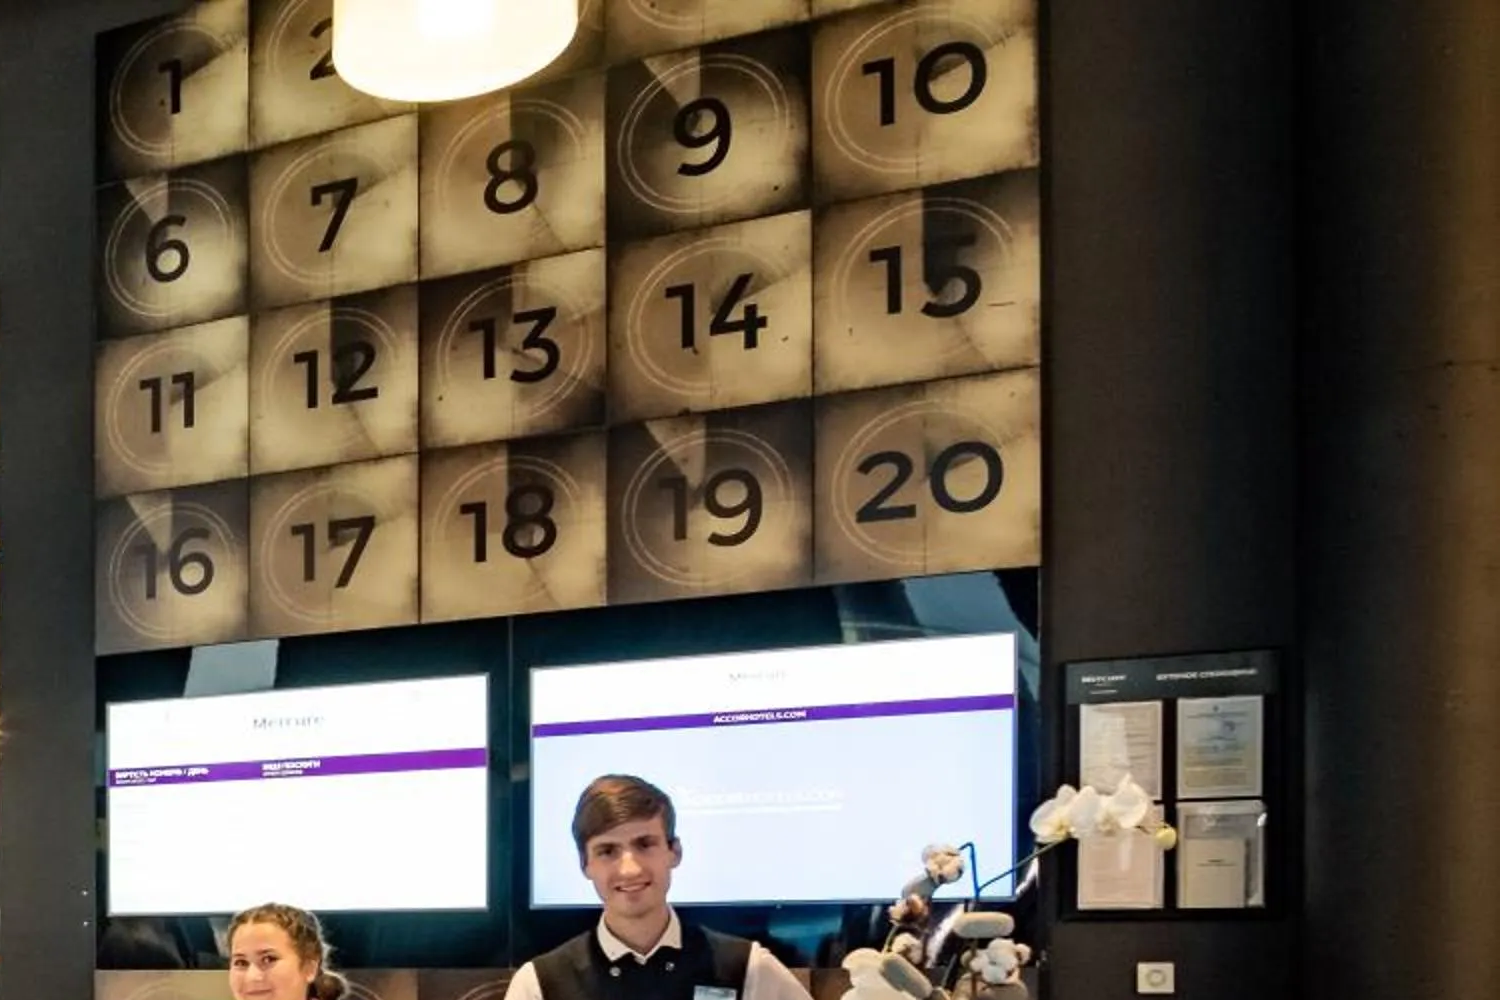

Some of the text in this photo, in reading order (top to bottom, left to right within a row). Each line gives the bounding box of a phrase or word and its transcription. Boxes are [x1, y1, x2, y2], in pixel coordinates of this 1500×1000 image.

[156, 60, 184, 115] 1
[862, 41, 988, 127] 10
[673, 98, 733, 176] 9
[483, 139, 539, 214] 8
[144, 216, 190, 282] 6
[310, 177, 359, 252] 7
[665, 273, 767, 350] 14
[868, 240, 983, 319] 15
[293, 341, 379, 409] 12
[469, 308, 562, 383] 13
[139, 371, 196, 434] 11
[657, 468, 764, 547] 19
[854, 440, 1005, 524] 20
[290, 514, 376, 589] 17
[459, 483, 558, 563] 18
[138, 528, 216, 600] 16
